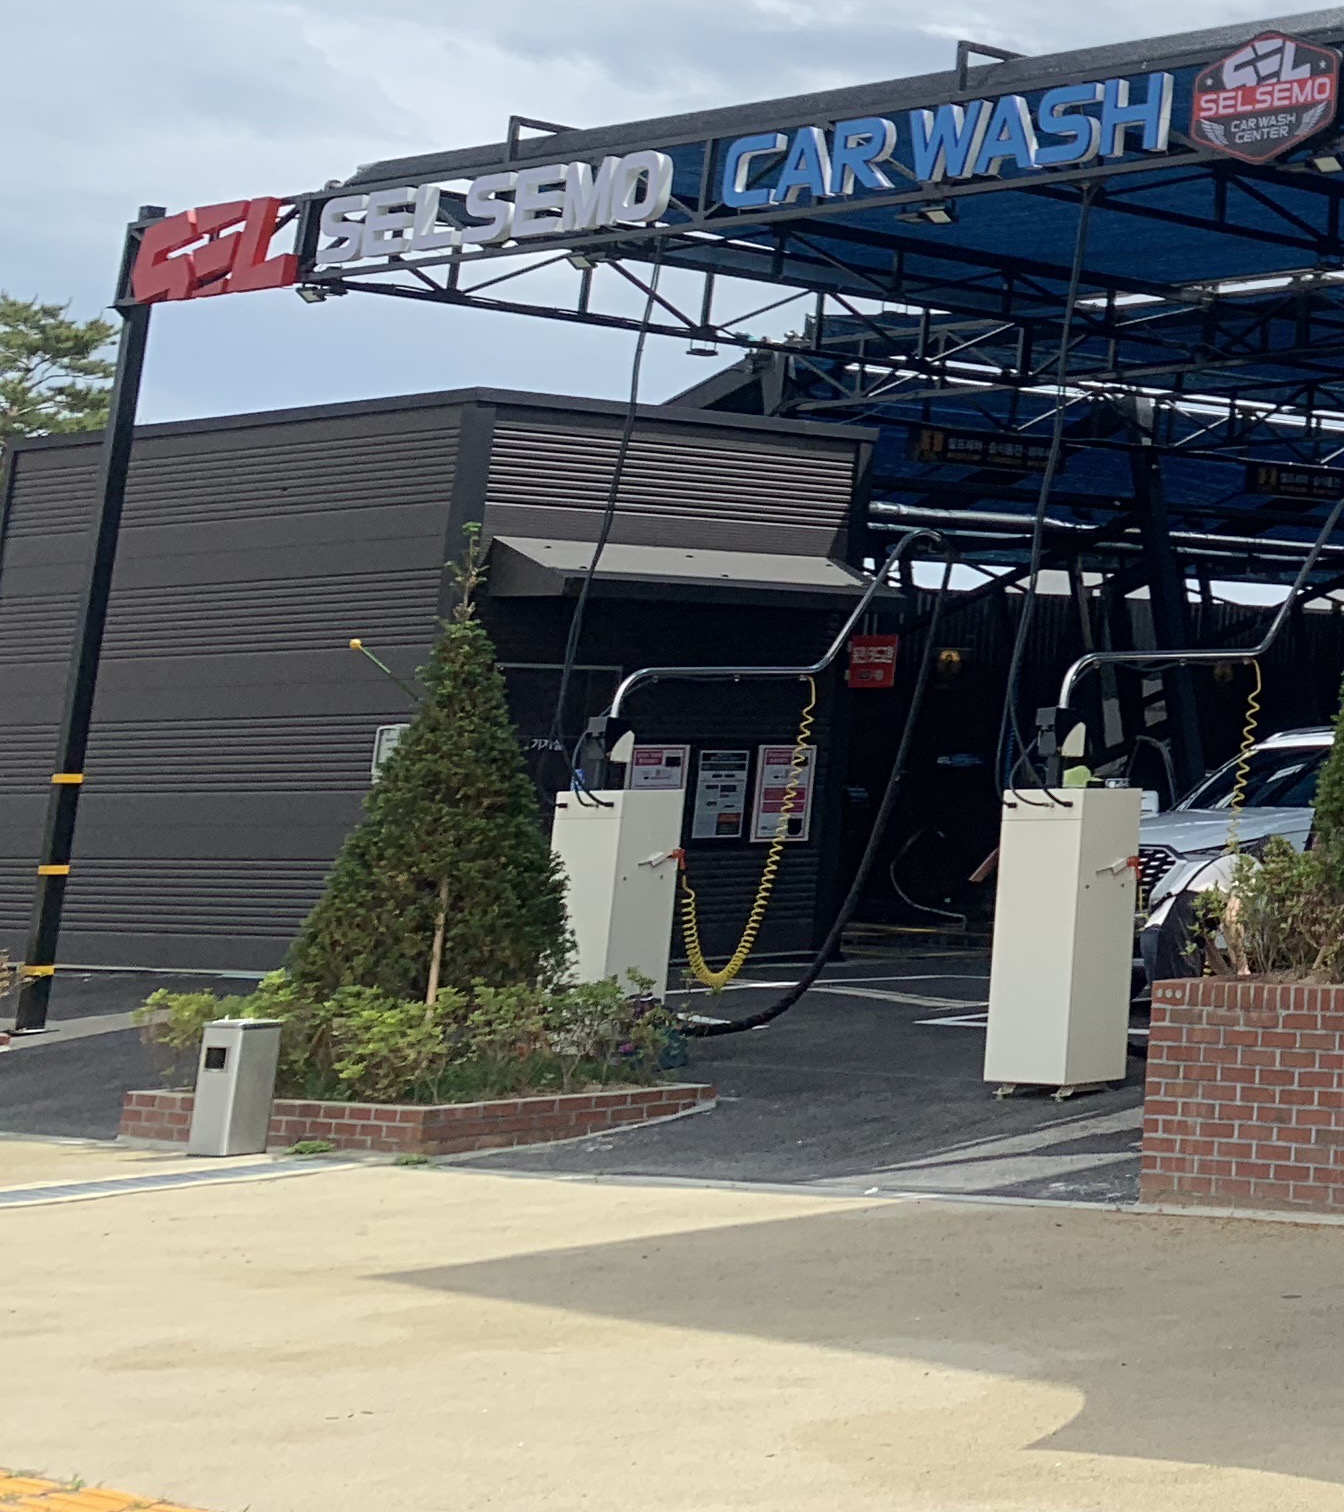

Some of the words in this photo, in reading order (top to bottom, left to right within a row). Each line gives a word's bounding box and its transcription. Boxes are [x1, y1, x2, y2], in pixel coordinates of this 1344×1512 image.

[1199, 77, 1332, 118] SELSEMO
[1231, 118, 1256, 133] CAR
[1258, 112, 1297, 128] WASH
[1235, 125, 1290, 145] CENTER
[722, 116, 897, 208] CAR
[910, 72, 1175, 183] WASH
